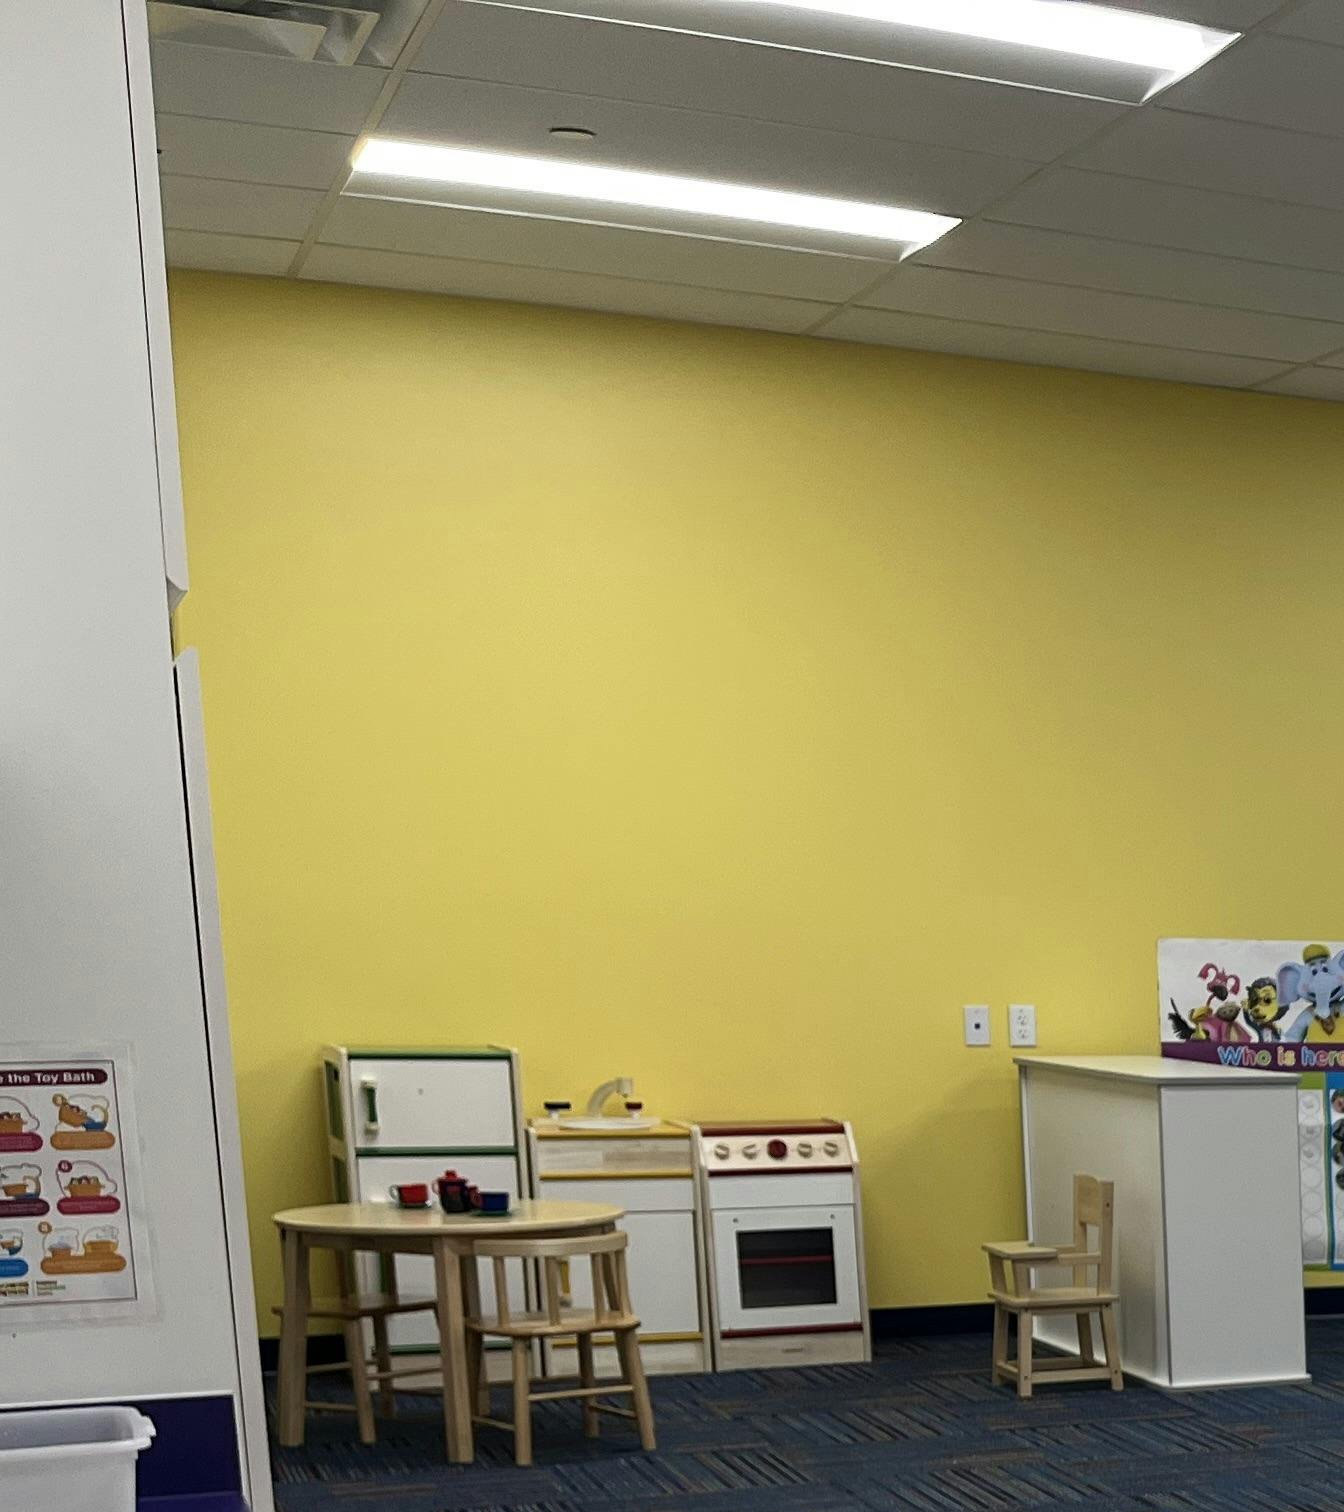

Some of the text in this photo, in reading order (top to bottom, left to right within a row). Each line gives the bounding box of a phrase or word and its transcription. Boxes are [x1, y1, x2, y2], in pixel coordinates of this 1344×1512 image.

[1217, 1046, 1271, 1066] Who
[1277, 1046, 1296, 1066] is
[8, 1073, 30, 1084] the
[34, 1072, 59, 1086] Toy
[63, 1071, 95, 1083] Bath
